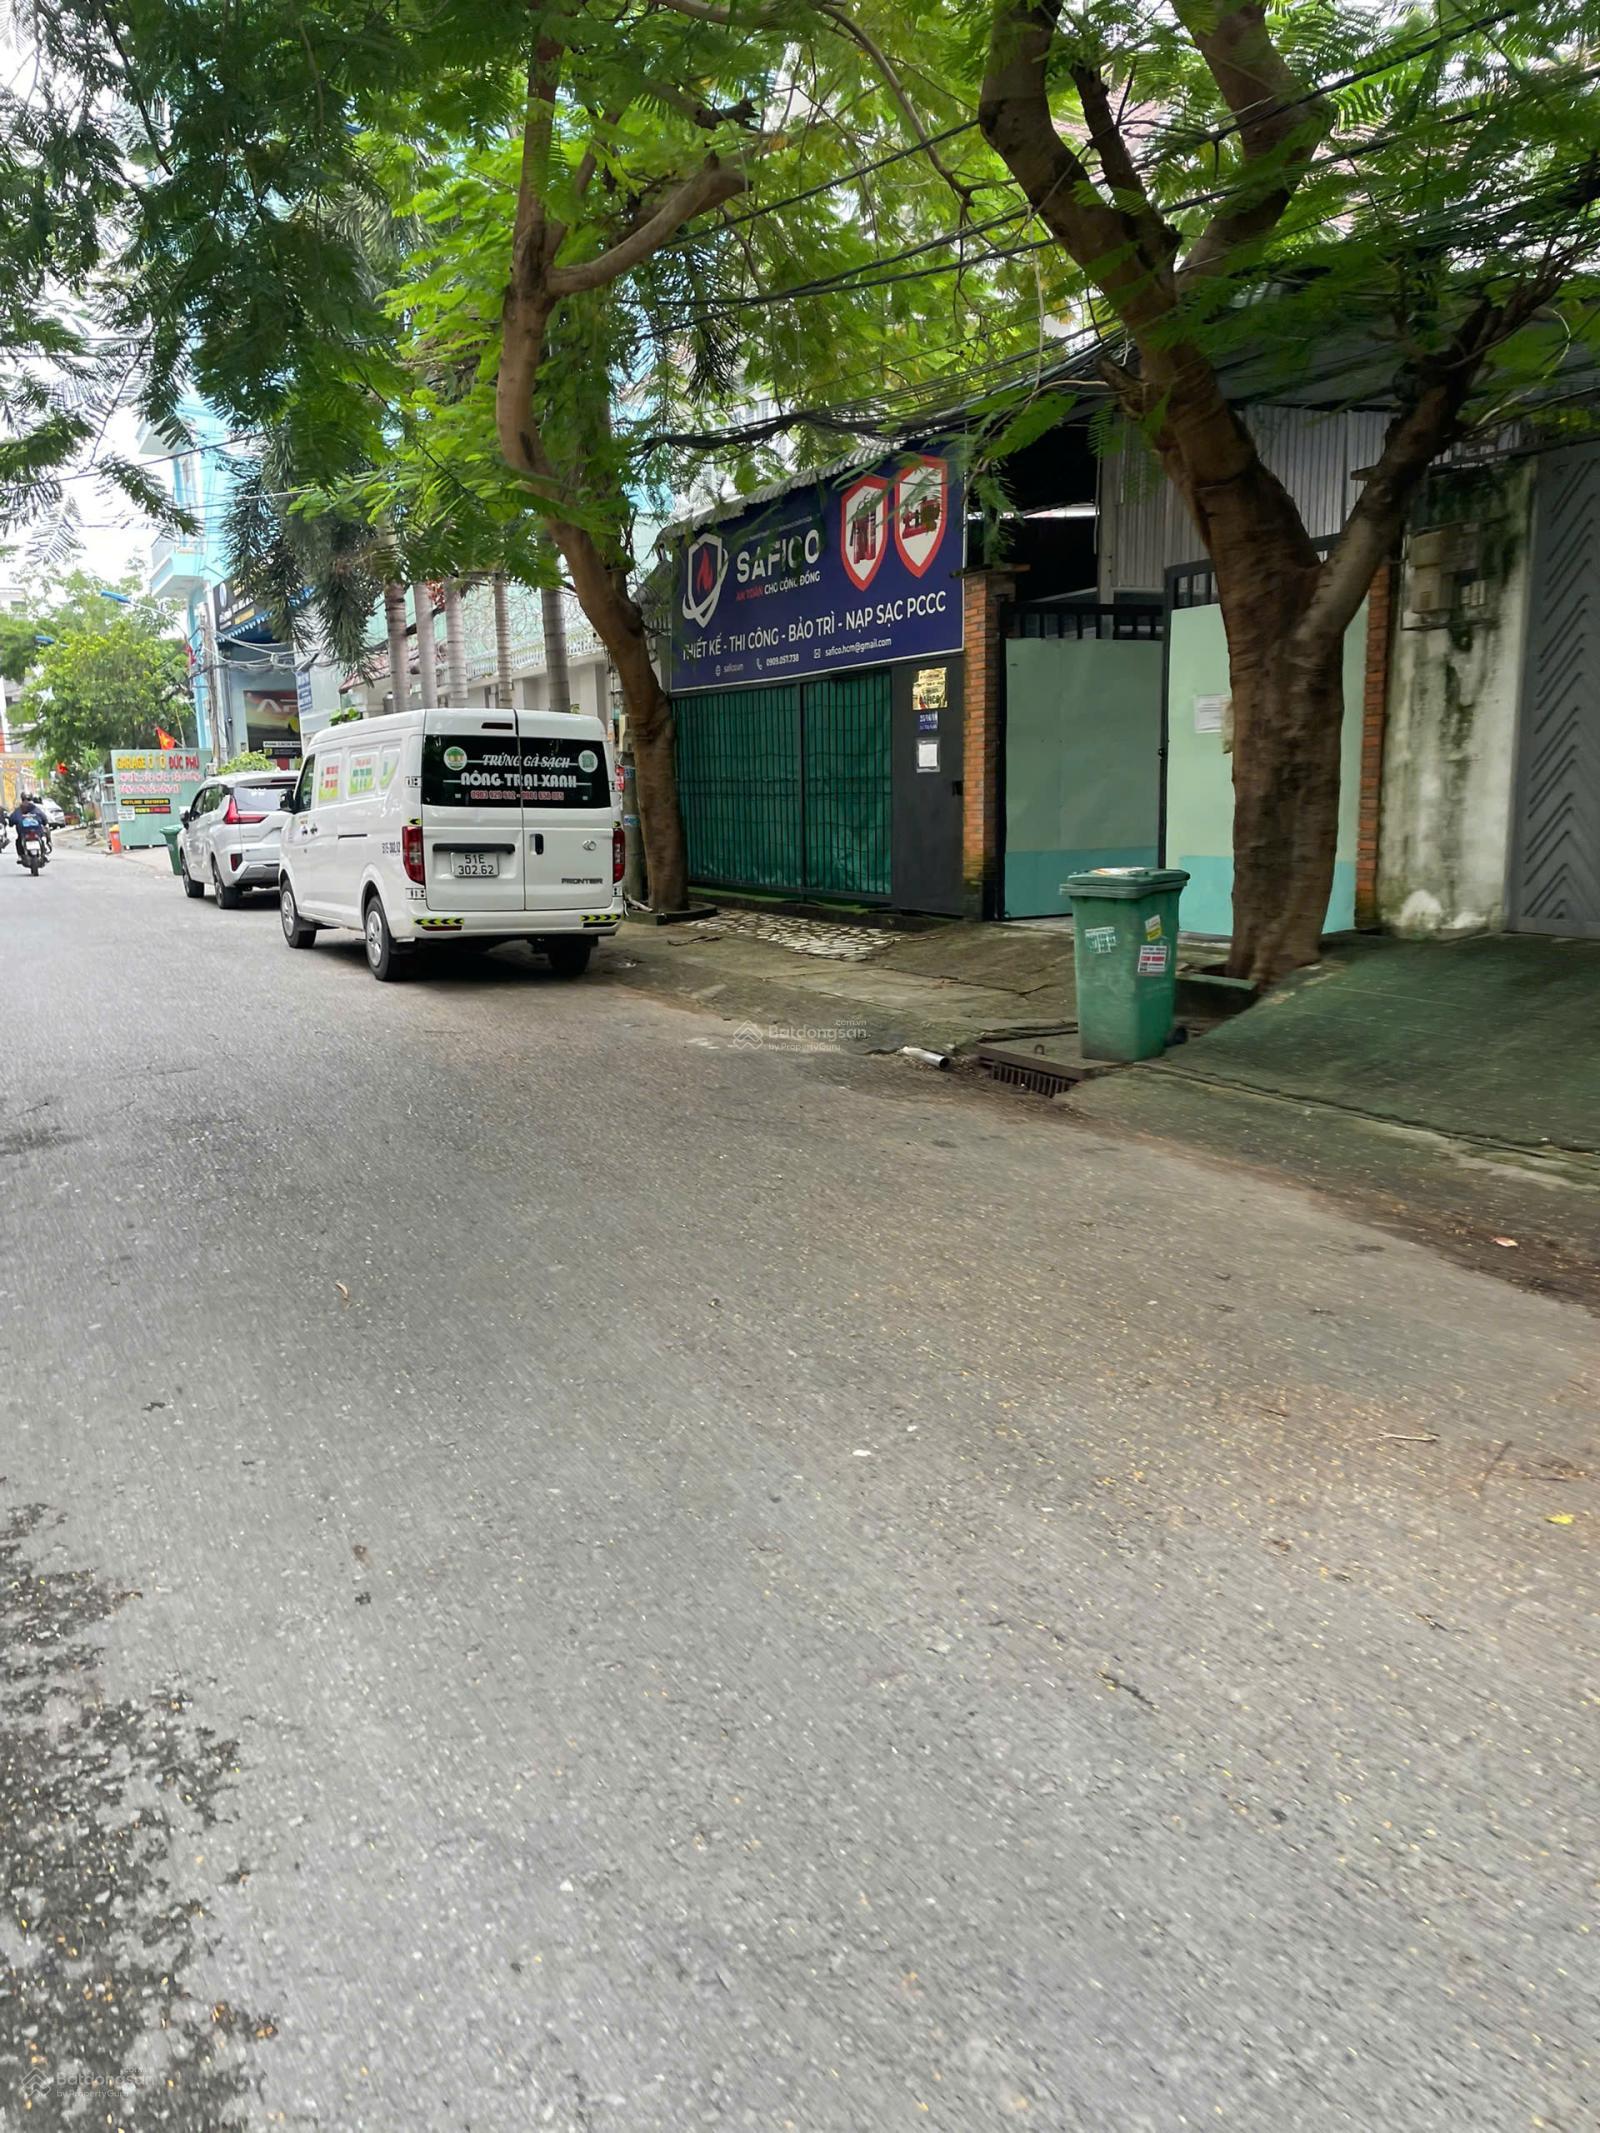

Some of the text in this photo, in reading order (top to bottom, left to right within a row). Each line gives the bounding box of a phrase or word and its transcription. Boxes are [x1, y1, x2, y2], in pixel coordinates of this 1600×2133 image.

[737, 529, 820, 583] SAFICO
[764, 580, 778, 595] CHO
[709, 632, 722, 657] KẾ
[729, 633, 746, 653] THI
[748, 626, 779, 650] CÔNG
[788, 615, 814, 642] BẢO
[816, 610, 835, 636] TRÌ
[846, 607, 873, 633] NẠP
[876, 600, 904, 628] SẠC
[907, 590, 946, 619] PCCC
[825, 638, 892, 656] safico.hcm@gmail.com
[482, 752, 571, 770] TRỨNG GÀ SẠCH
[461, 770, 577, 790] NÔNG TRẠI XANH
[465, 853, 485, 864] 51E
[458, 865, 494, 875] 302.62
